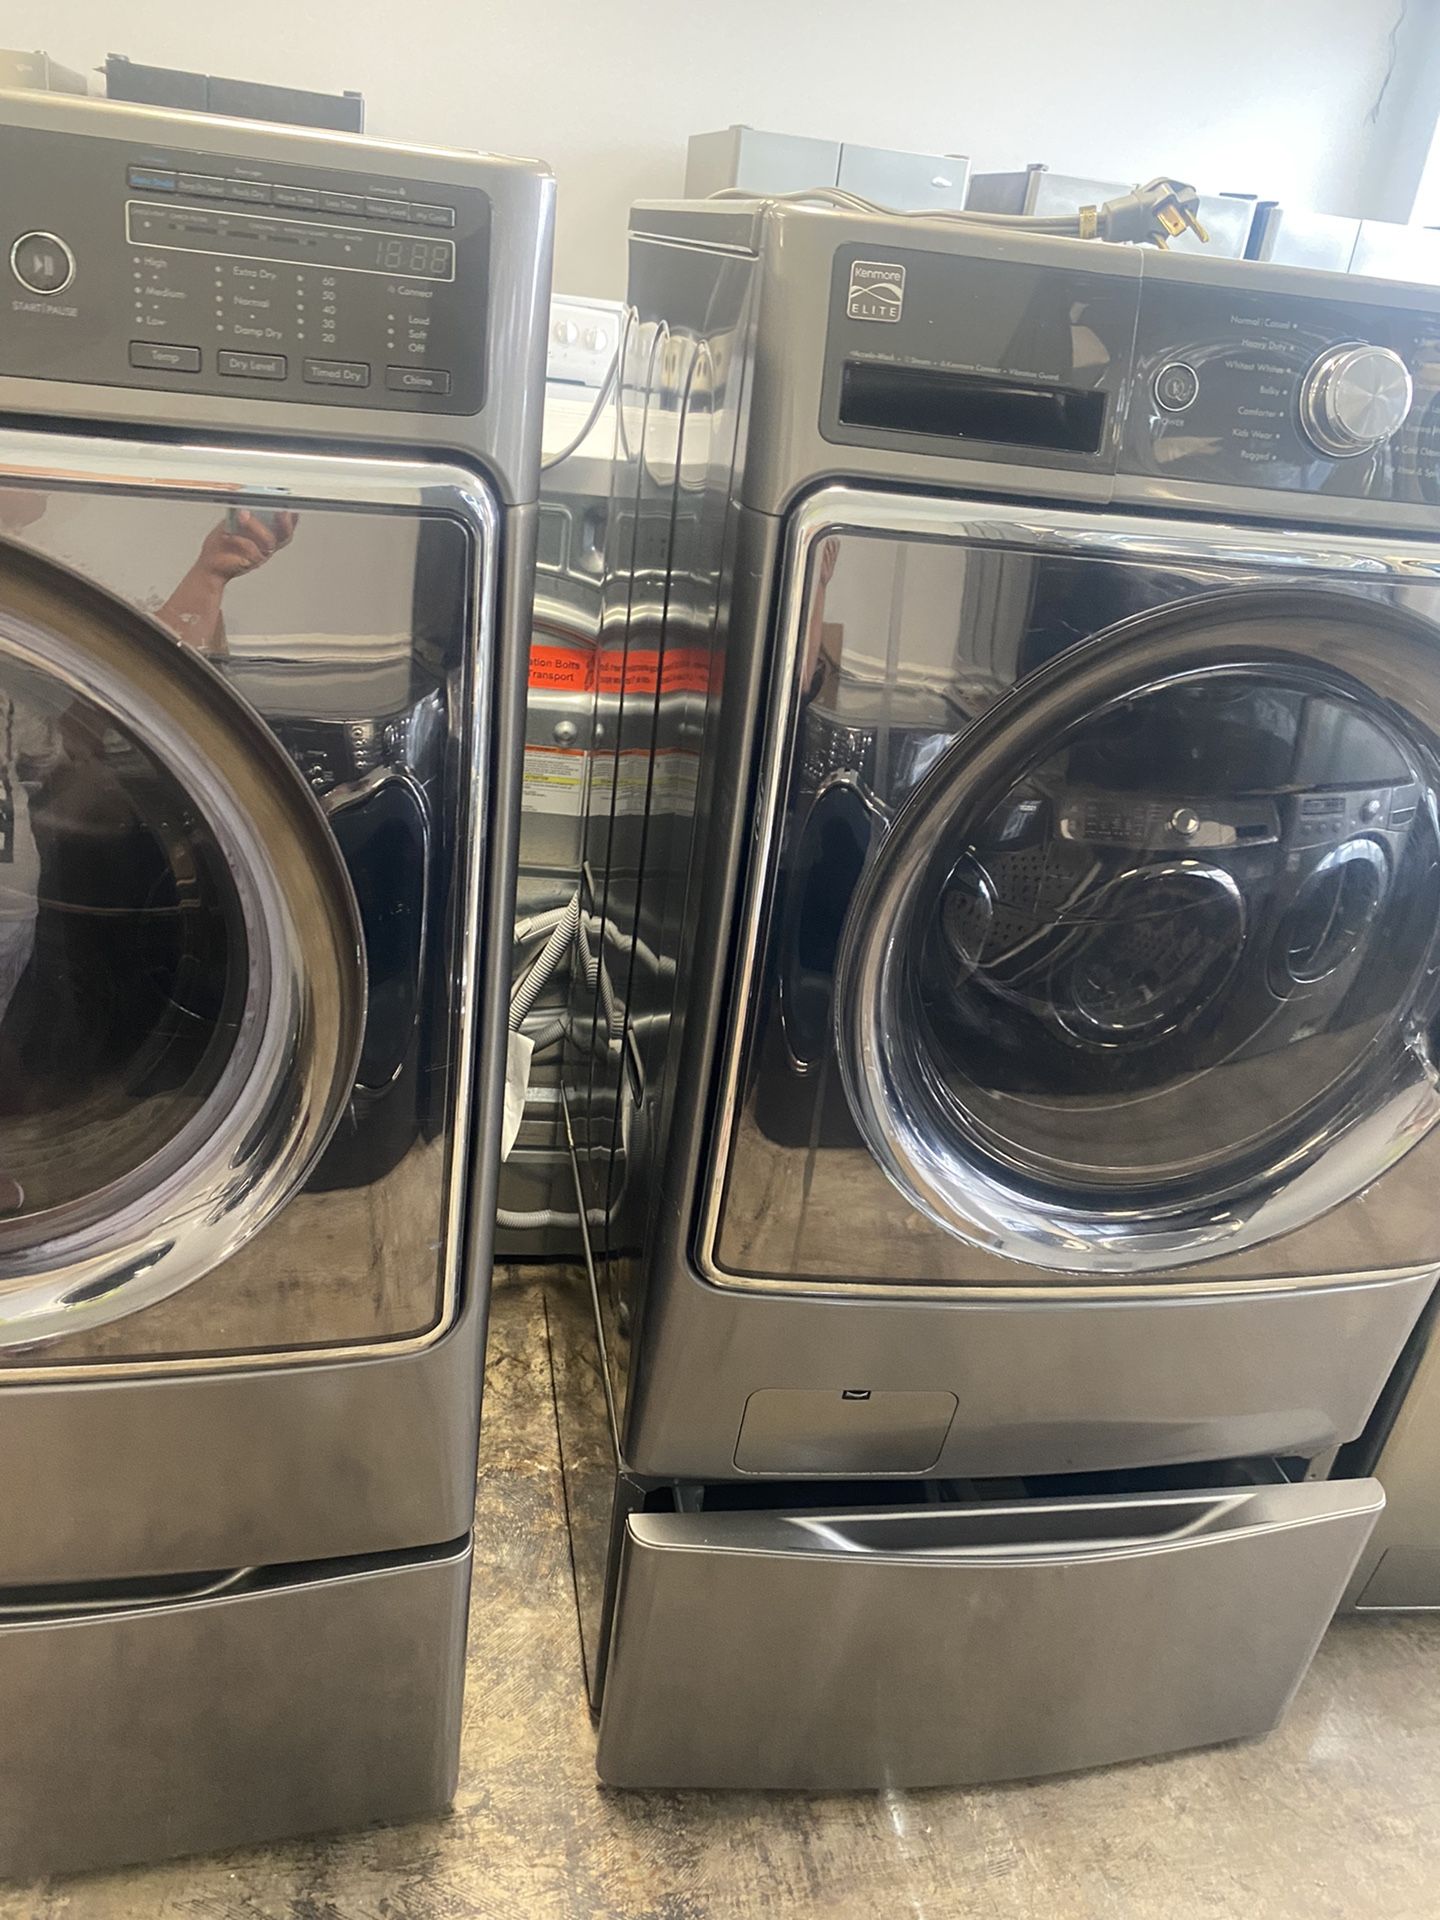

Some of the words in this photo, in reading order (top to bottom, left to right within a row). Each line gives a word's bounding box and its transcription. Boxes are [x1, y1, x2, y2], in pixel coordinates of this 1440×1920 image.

[259, 267, 277, 281] Dry
[854, 267, 902, 281] Kenmore
[145, 285, 187, 300] Medium
[234, 295, 270, 308] Normal
[322, 304, 336, 315] 40
[851, 303, 898, 318] ELITE
[146, 315, 167, 326] Low
[322, 318, 336, 329] 30
[408, 314, 431, 326] Loud
[234, 324, 264, 339] Damp
[265, 327, 283, 340] Dry
[322, 332, 336, 344] 20
[151, 350, 181, 364] Temp
[229, 357, 248, 372] Dry
[249, 359, 276, 372] Level
[312, 365, 342, 380] Timed
[343, 368, 362, 382] Dry
